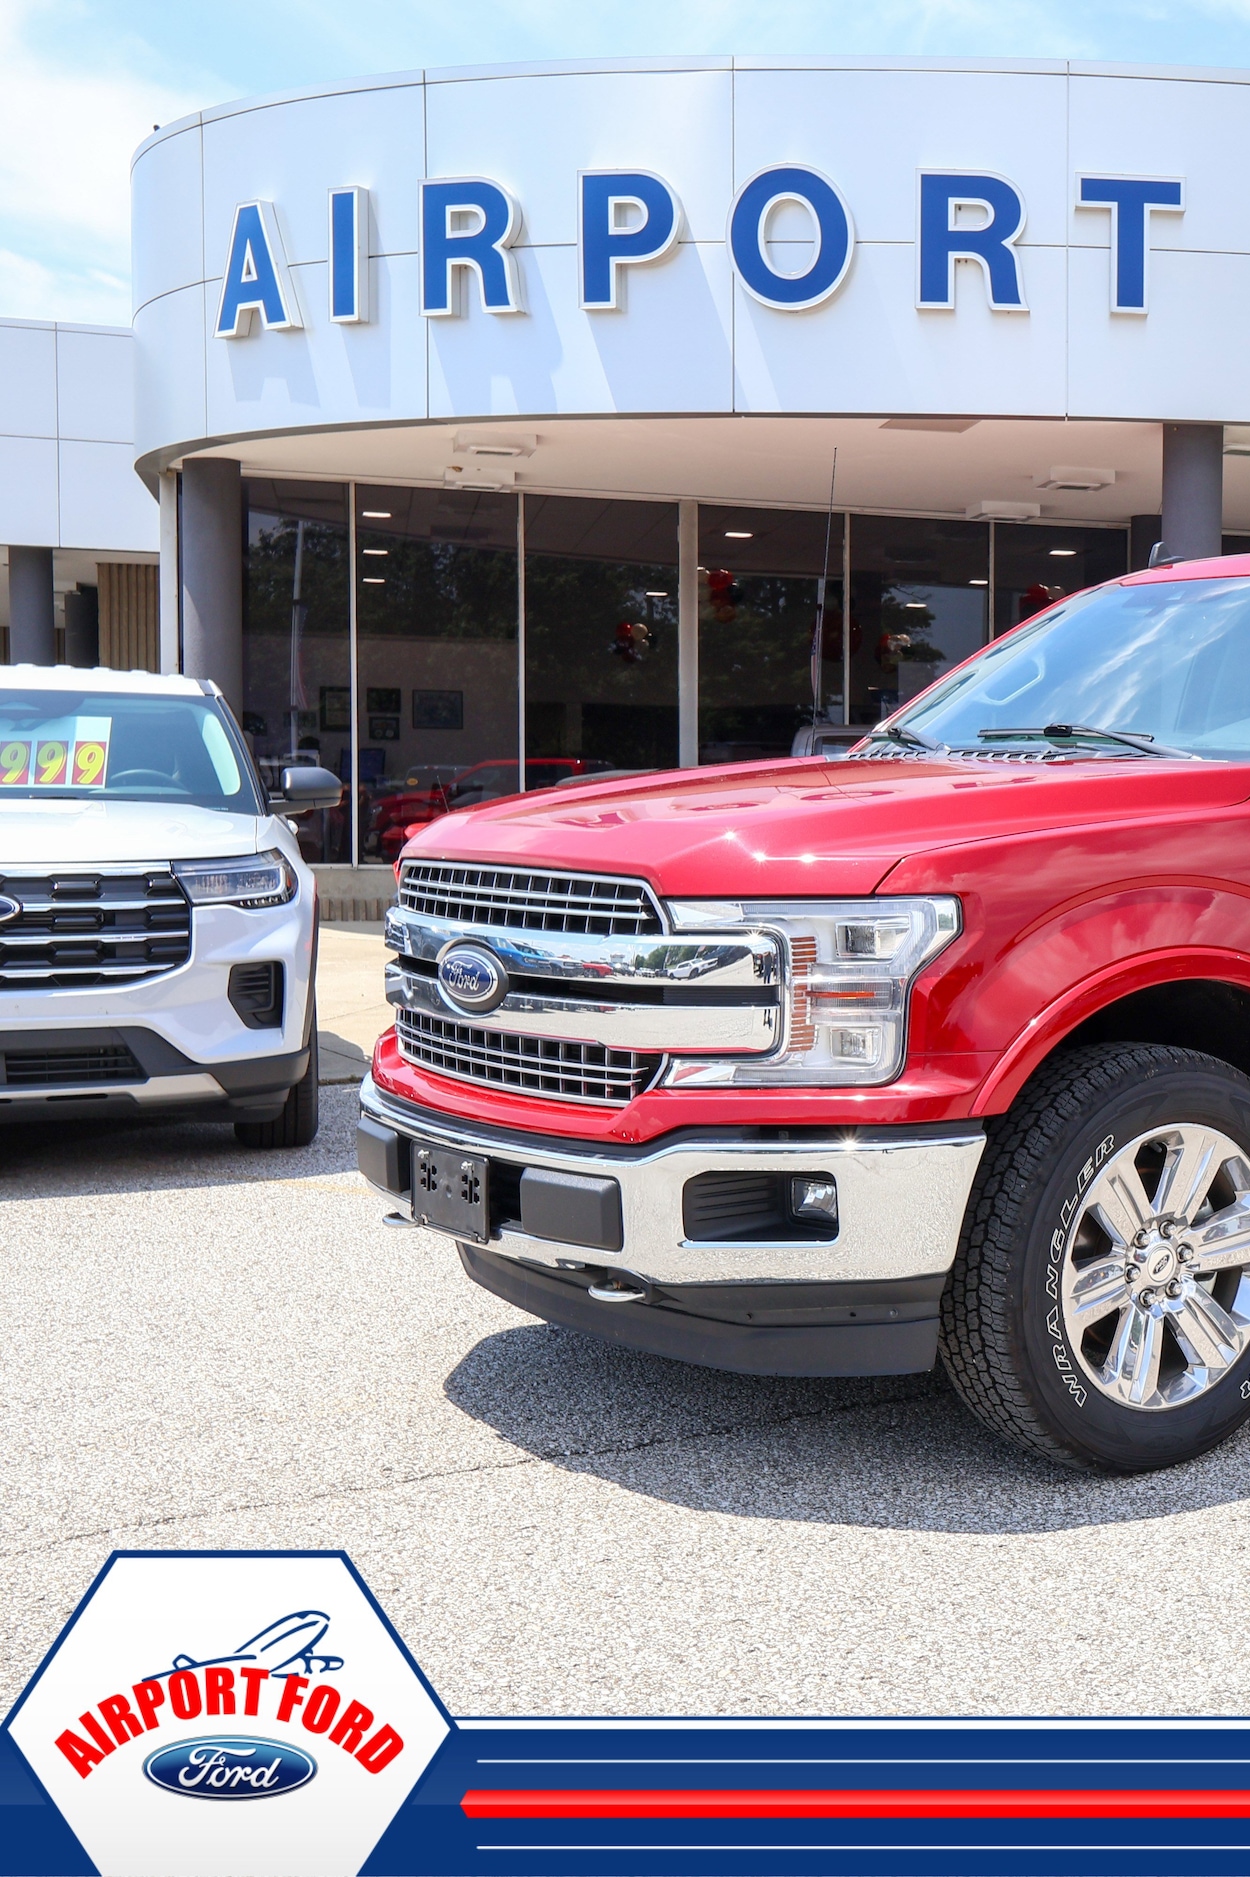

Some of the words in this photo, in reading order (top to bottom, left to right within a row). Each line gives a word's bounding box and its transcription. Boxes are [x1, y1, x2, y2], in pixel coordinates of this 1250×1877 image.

[213, 162, 1187, 340] AIRPORT
[448, 960, 481, 991] Ford
[1045, 1134, 1115, 1408] WRANGLER
